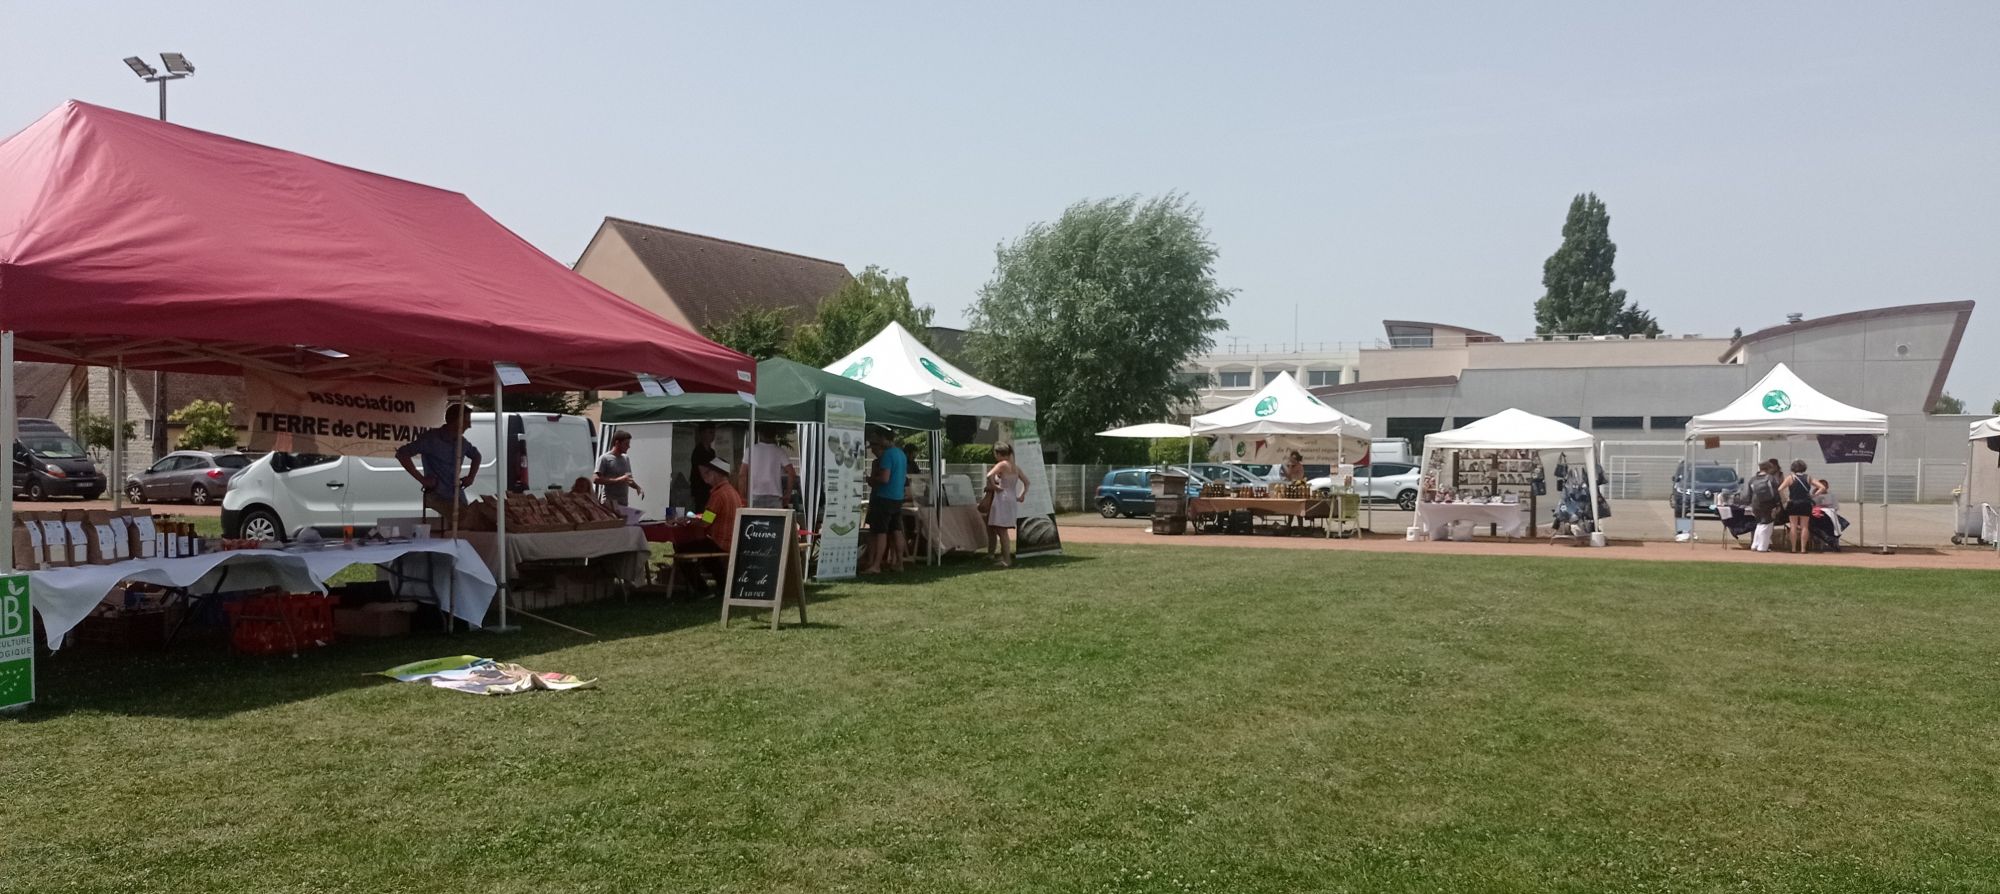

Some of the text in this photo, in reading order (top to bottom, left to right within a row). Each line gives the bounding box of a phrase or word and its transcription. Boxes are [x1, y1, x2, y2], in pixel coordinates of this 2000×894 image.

[307, 391, 416, 414] Association
[256, 411, 330, 437] TERRE
[332, 419, 355, 438] de
[0, 595, 22, 636] B
[0, 636, 31, 648] ULTURE
